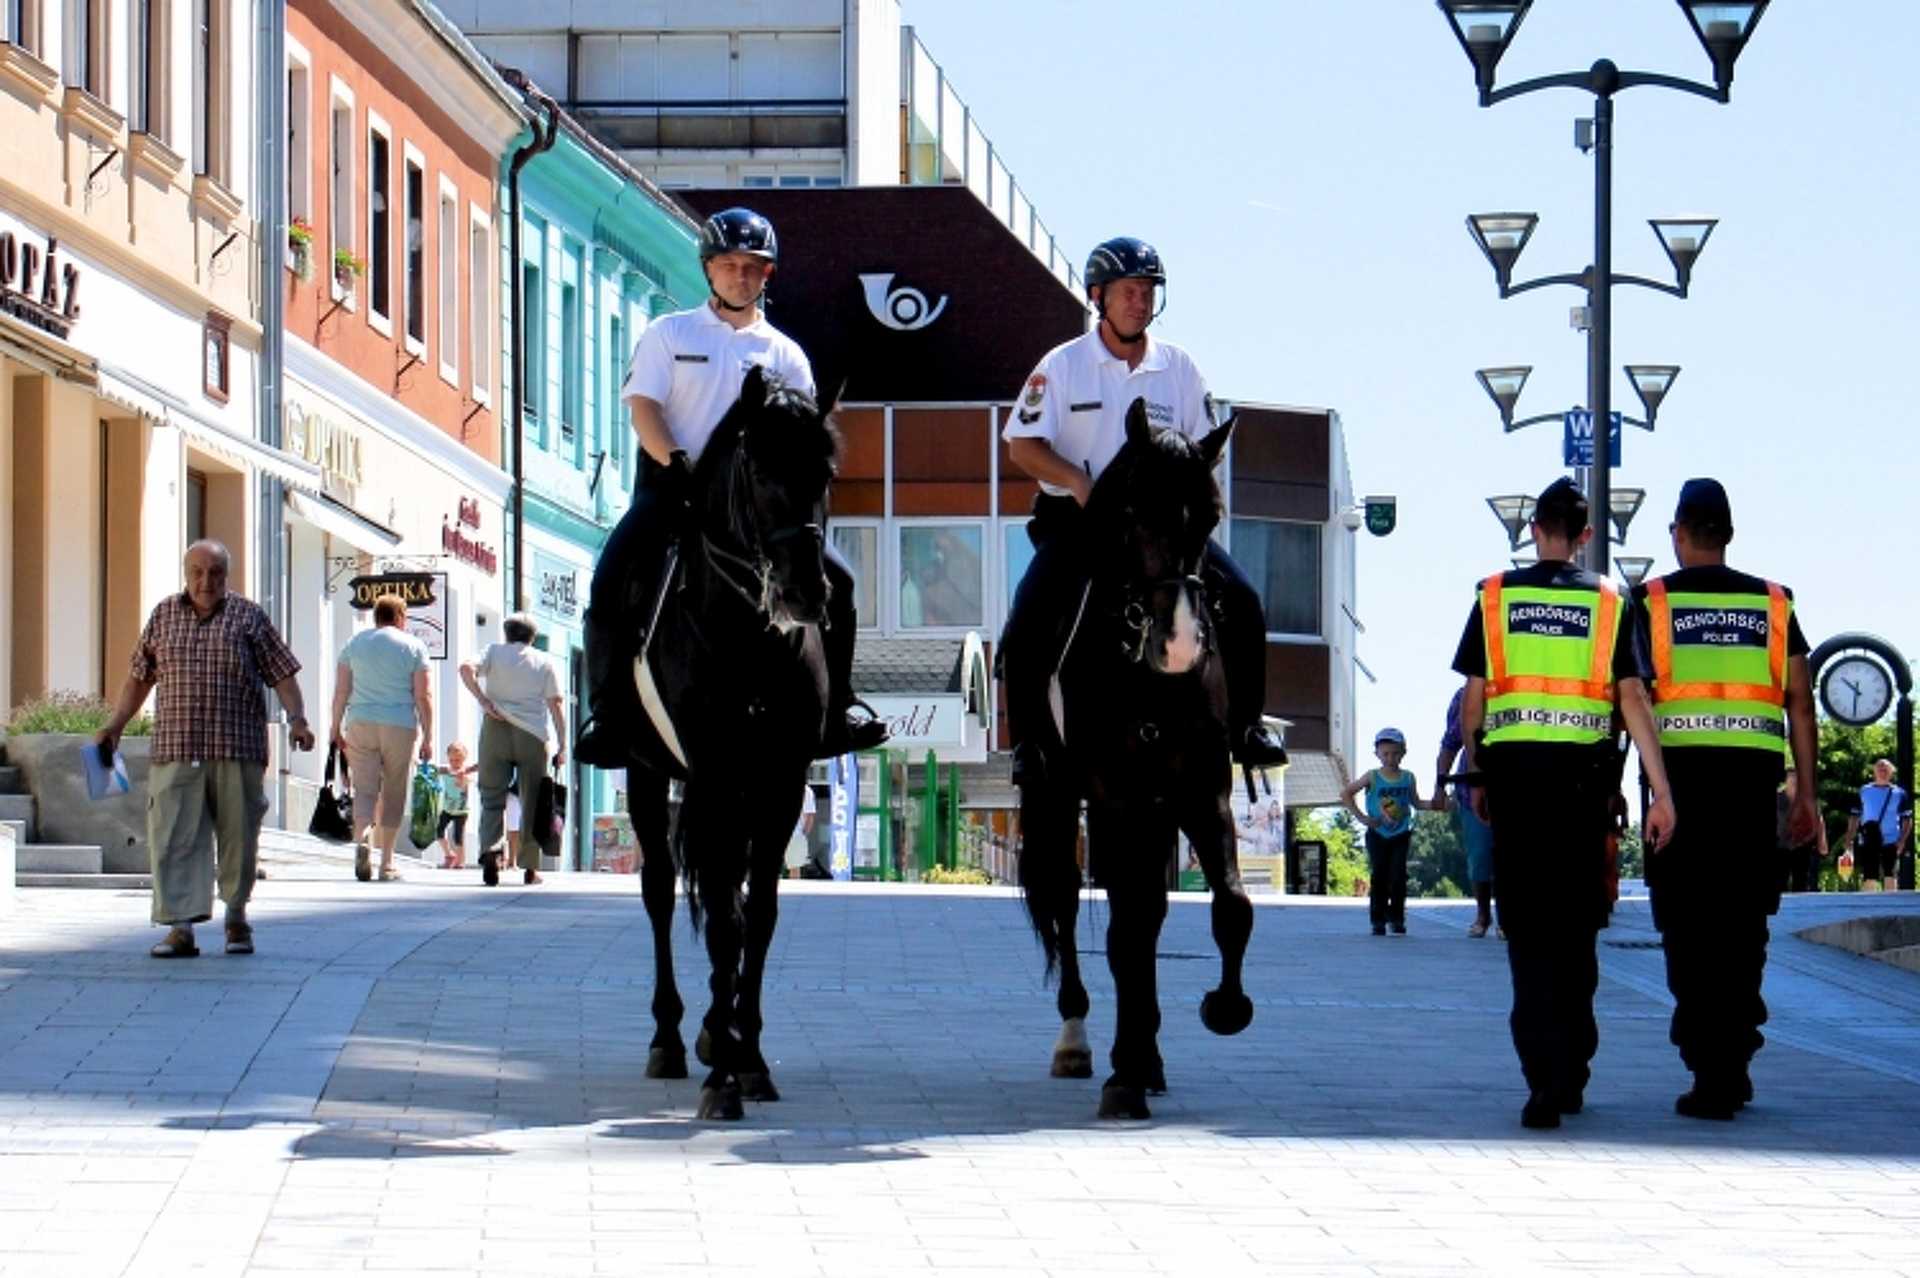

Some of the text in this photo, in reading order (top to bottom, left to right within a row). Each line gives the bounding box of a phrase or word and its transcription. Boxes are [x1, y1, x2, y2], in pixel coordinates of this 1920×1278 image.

[356, 581, 430, 602] OPTIKA
[1530, 622, 1564, 635] POLICE
[1701, 631, 1740, 643] POLICE
